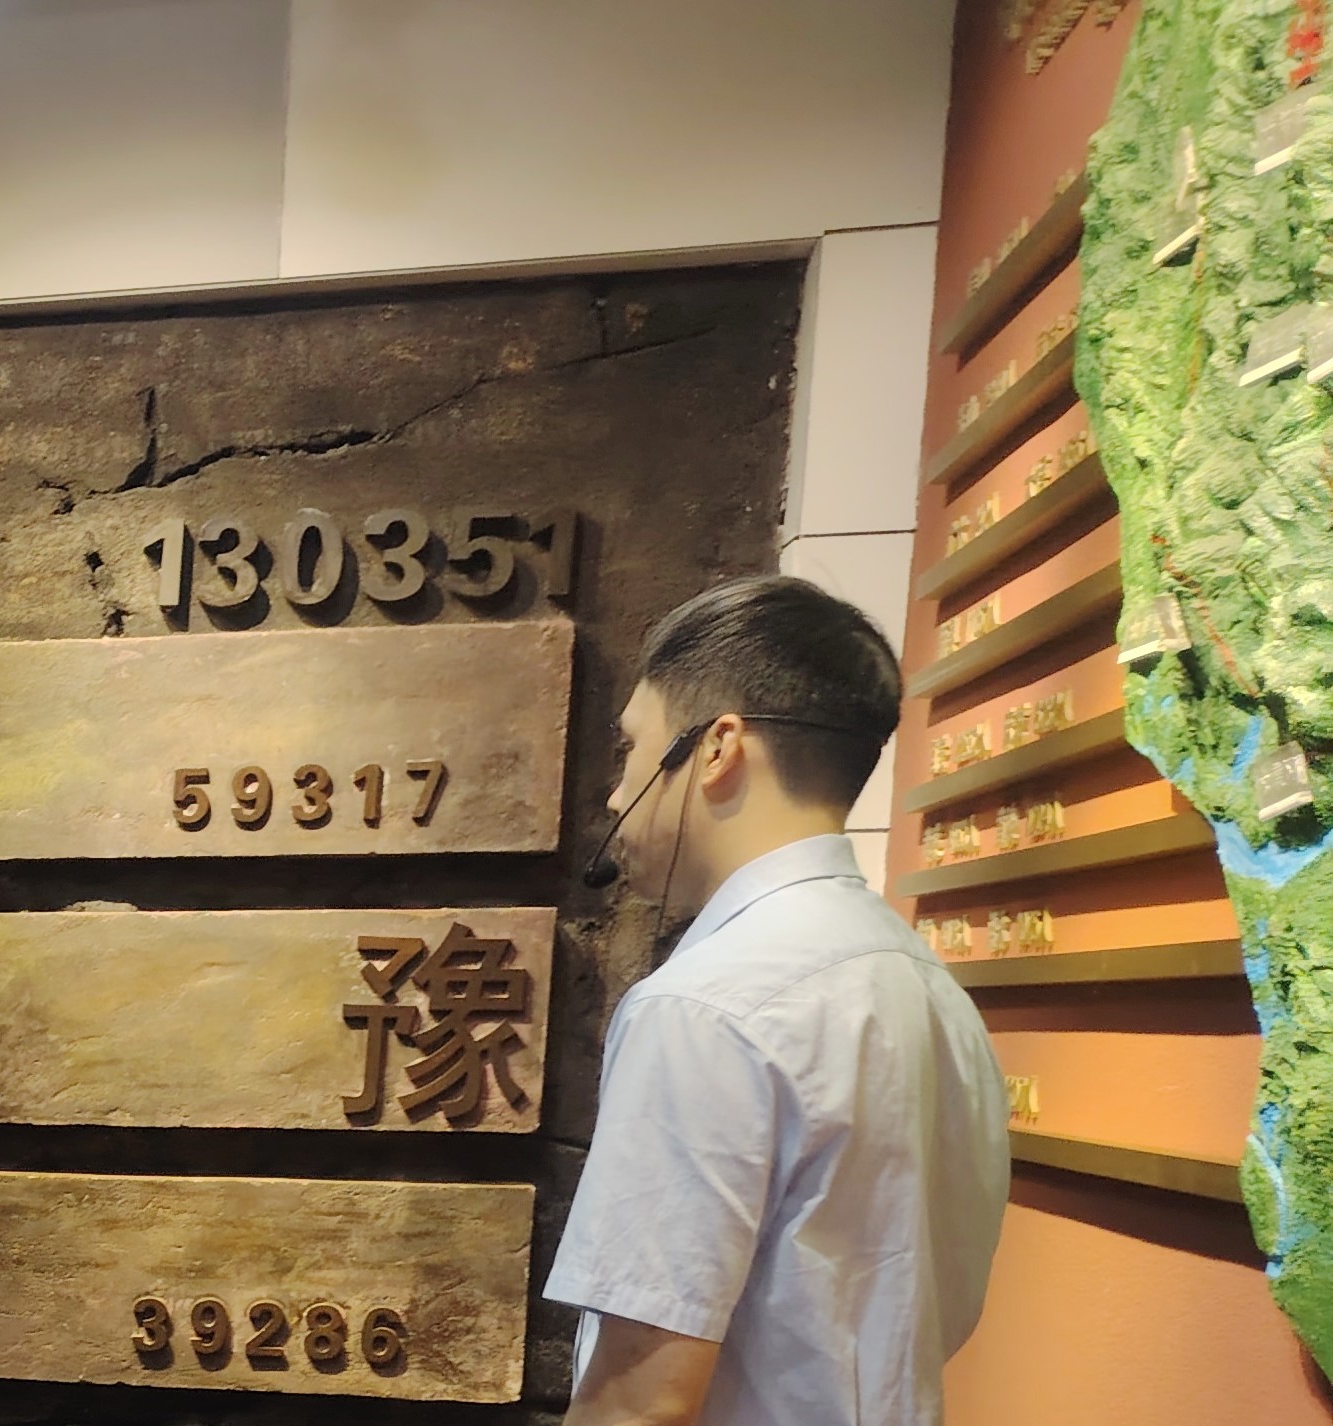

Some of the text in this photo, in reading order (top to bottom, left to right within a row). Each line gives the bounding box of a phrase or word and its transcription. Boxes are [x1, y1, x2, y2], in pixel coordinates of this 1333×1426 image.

[143, 507, 579, 608] 130351
[173, 761, 446, 831] 59317
[342, 922, 529, 1120] 豫
[133, 1296, 406, 1367] 39286
